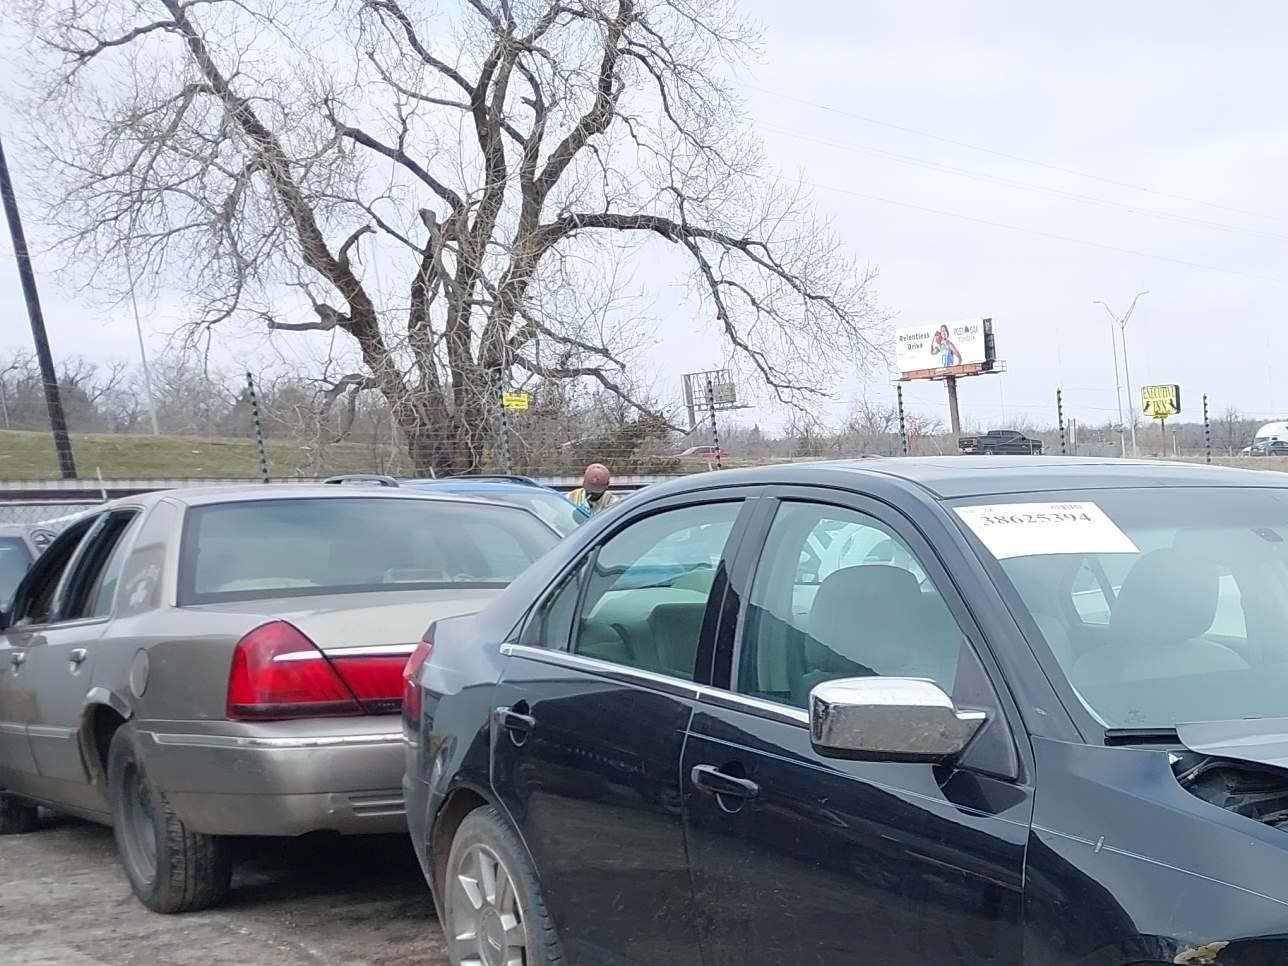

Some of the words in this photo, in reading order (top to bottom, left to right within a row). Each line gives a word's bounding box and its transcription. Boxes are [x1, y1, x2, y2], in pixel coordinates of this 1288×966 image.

[899, 331, 930, 342] Relentless
[907, 343, 923, 351] Drive
[1143, 386, 1175, 400] EXECUTIVE
[1153, 400, 1167, 411] INN
[979, 511, 1092, 527] 38625394
